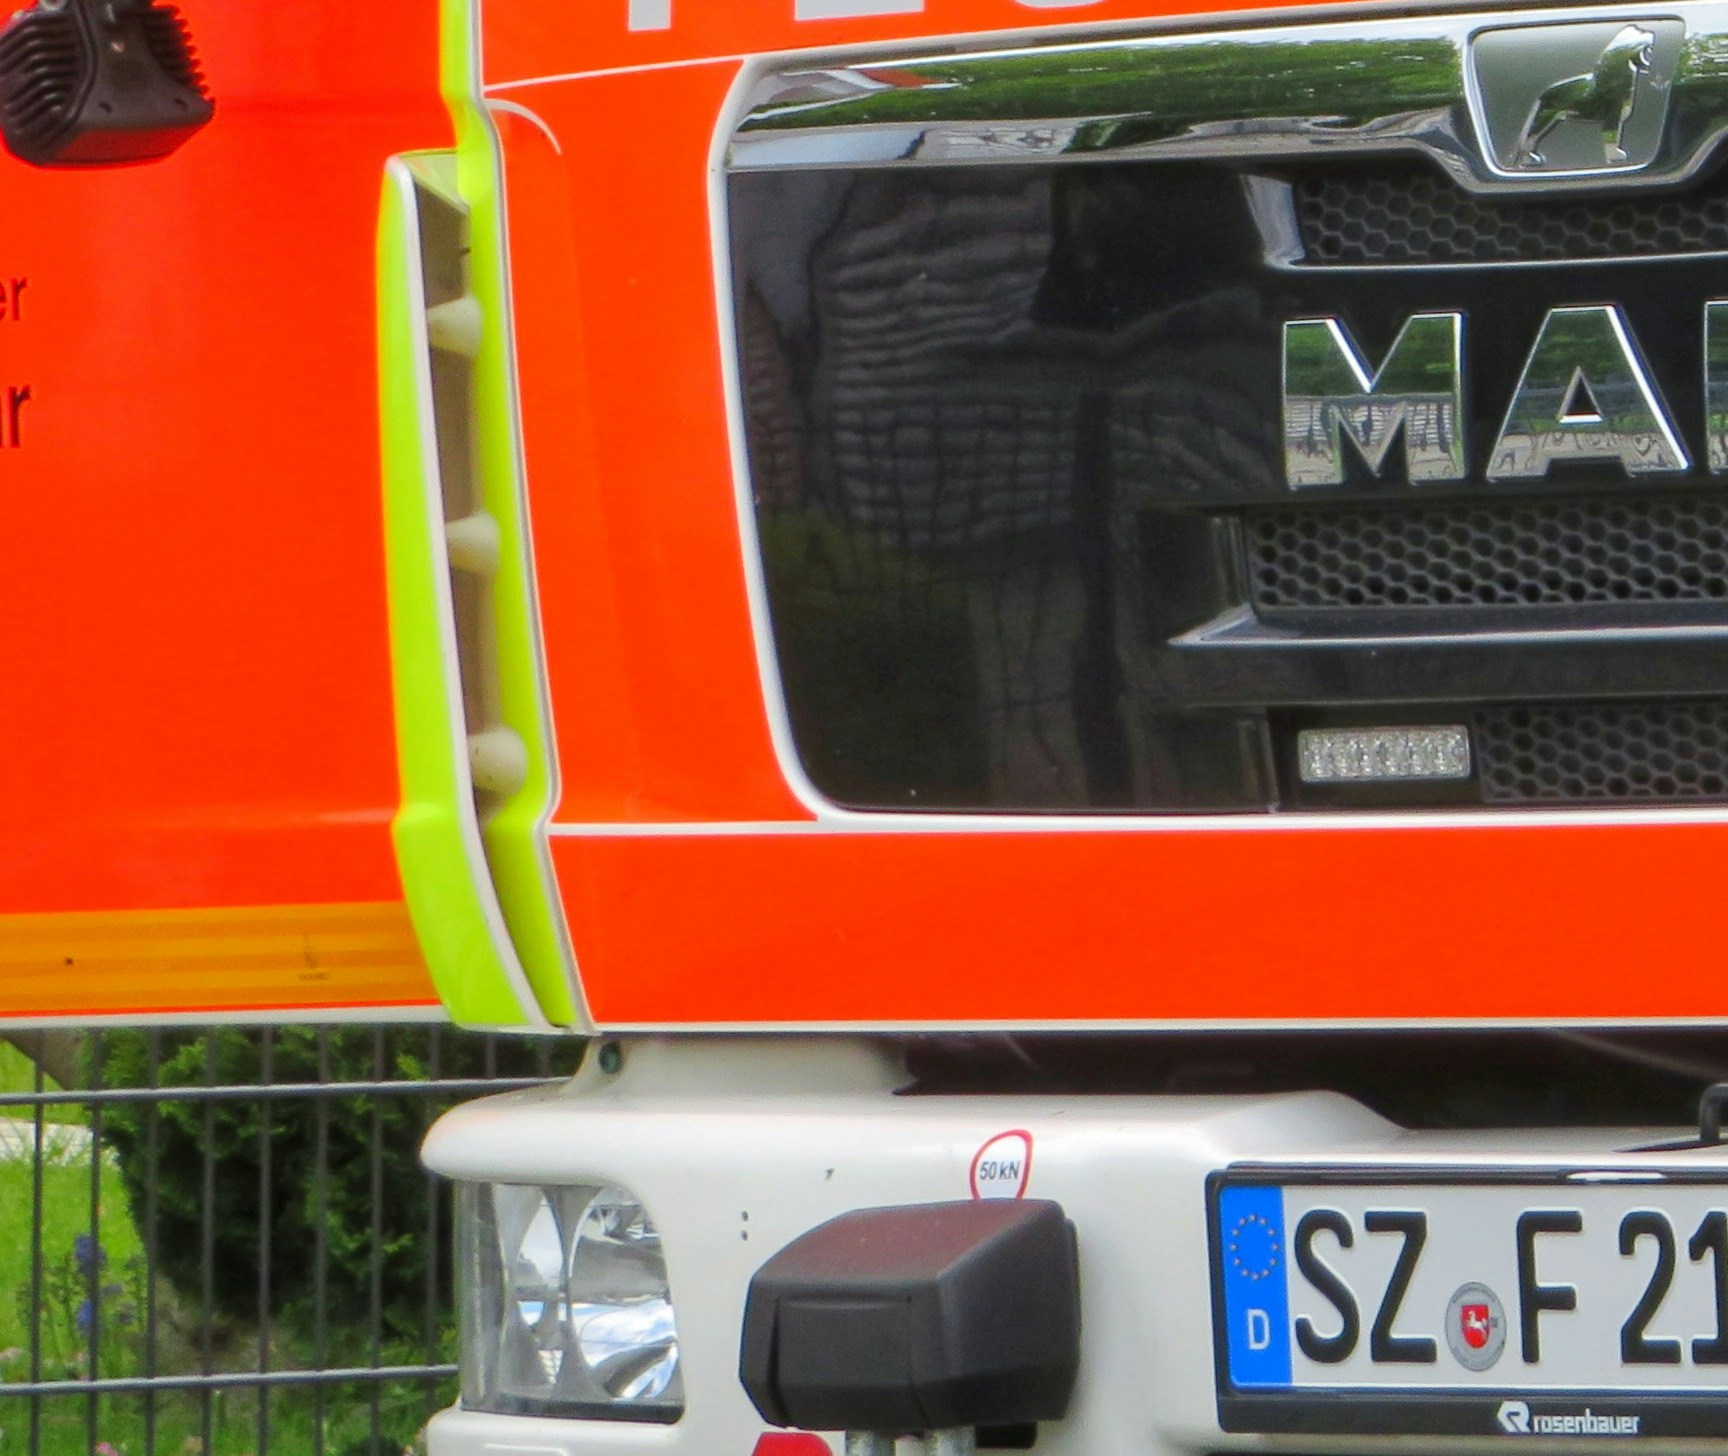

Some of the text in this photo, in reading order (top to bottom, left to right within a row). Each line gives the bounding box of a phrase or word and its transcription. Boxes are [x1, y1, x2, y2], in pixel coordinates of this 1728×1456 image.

[979, 1160, 1022, 1181] 50 kN
[1294, 1208, 1438, 1365] SZ
[1515, 1209, 1583, 1364] F
[1247, 1309, 1271, 1351] D
[1532, 1407, 1642, 1435] rosenbauer
